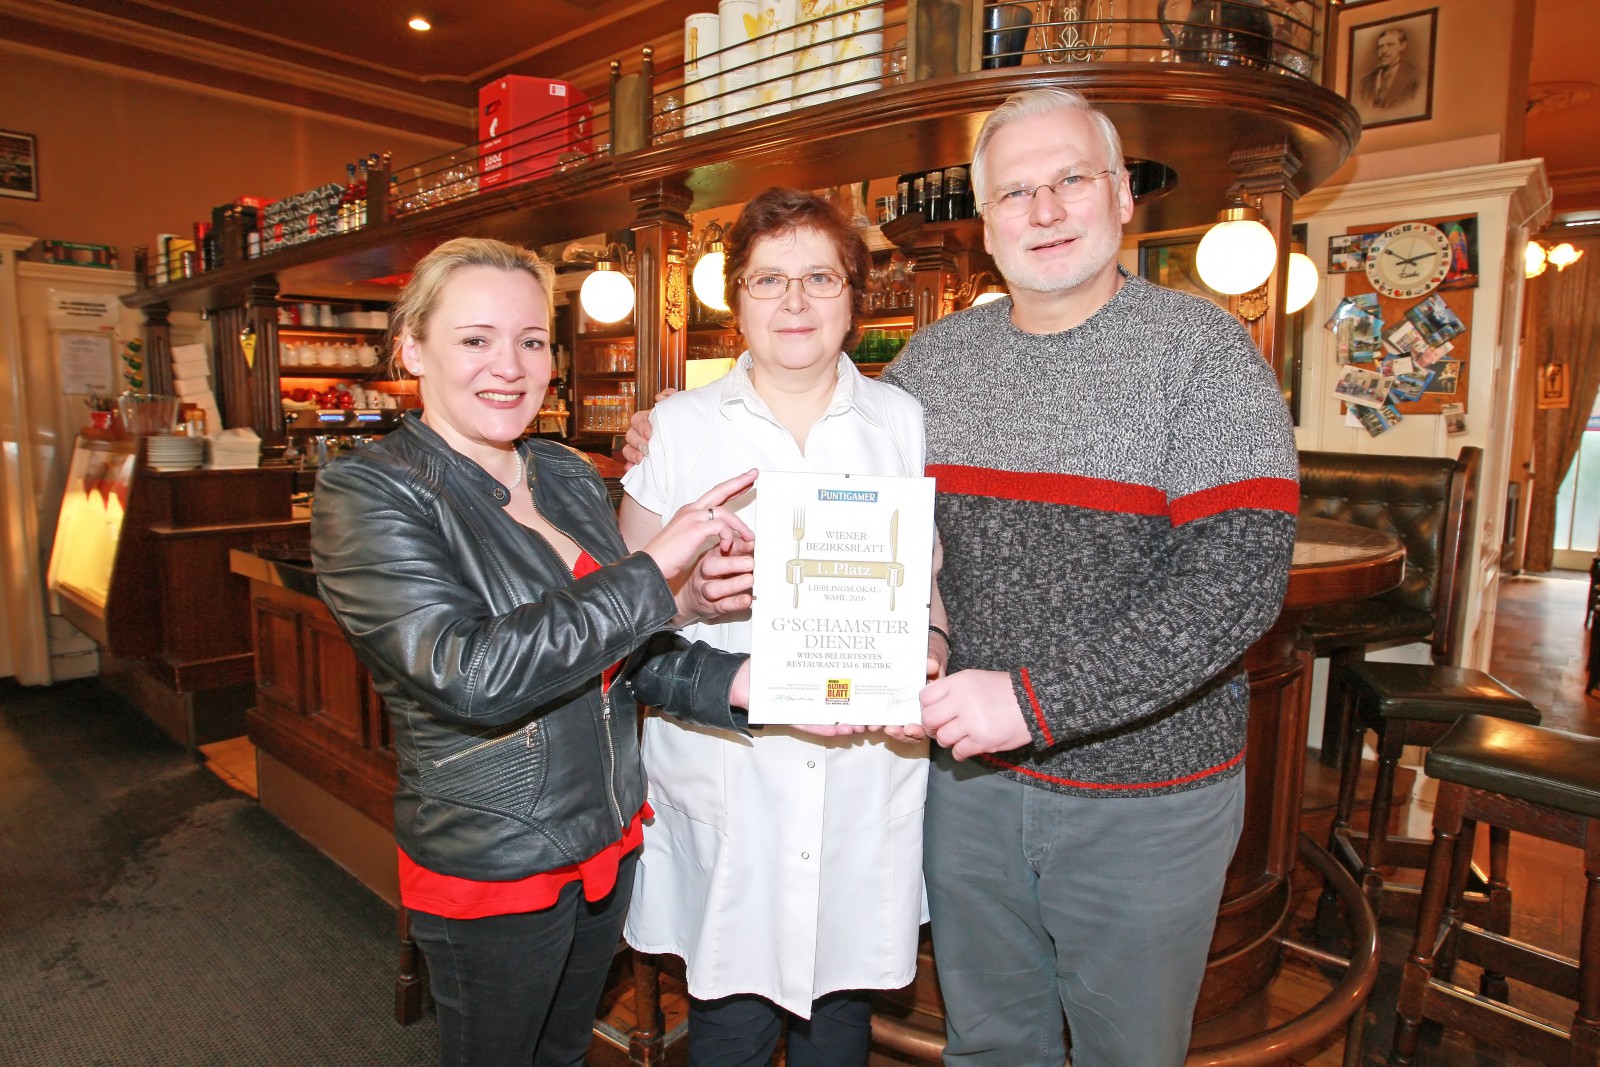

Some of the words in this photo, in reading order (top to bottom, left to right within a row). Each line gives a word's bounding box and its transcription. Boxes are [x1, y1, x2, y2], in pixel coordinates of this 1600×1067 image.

[1384, 231, 1393, 239] 11
[820, 490, 876, 502] PUNTIGAMER
[825, 531, 867, 541] WIENER
[806, 542, 885, 554] BEZIRKSBLATT
[817, 563, 828, 575] 1.
[833, 563, 873, 576] Platz
[808, 584, 881, 593] LIEBLINGSLOKAL-
[824, 593, 847, 601] WAHL
[849, 594, 866, 602] 2016
[804, 634, 876, 650] DIENER
[824, 652, 882, 660] BELIEBTESTES
[786, 660, 841, 669] RESTAURANT
[842, 661, 853, 669] IM
[828, 690, 848, 698] BLATT
